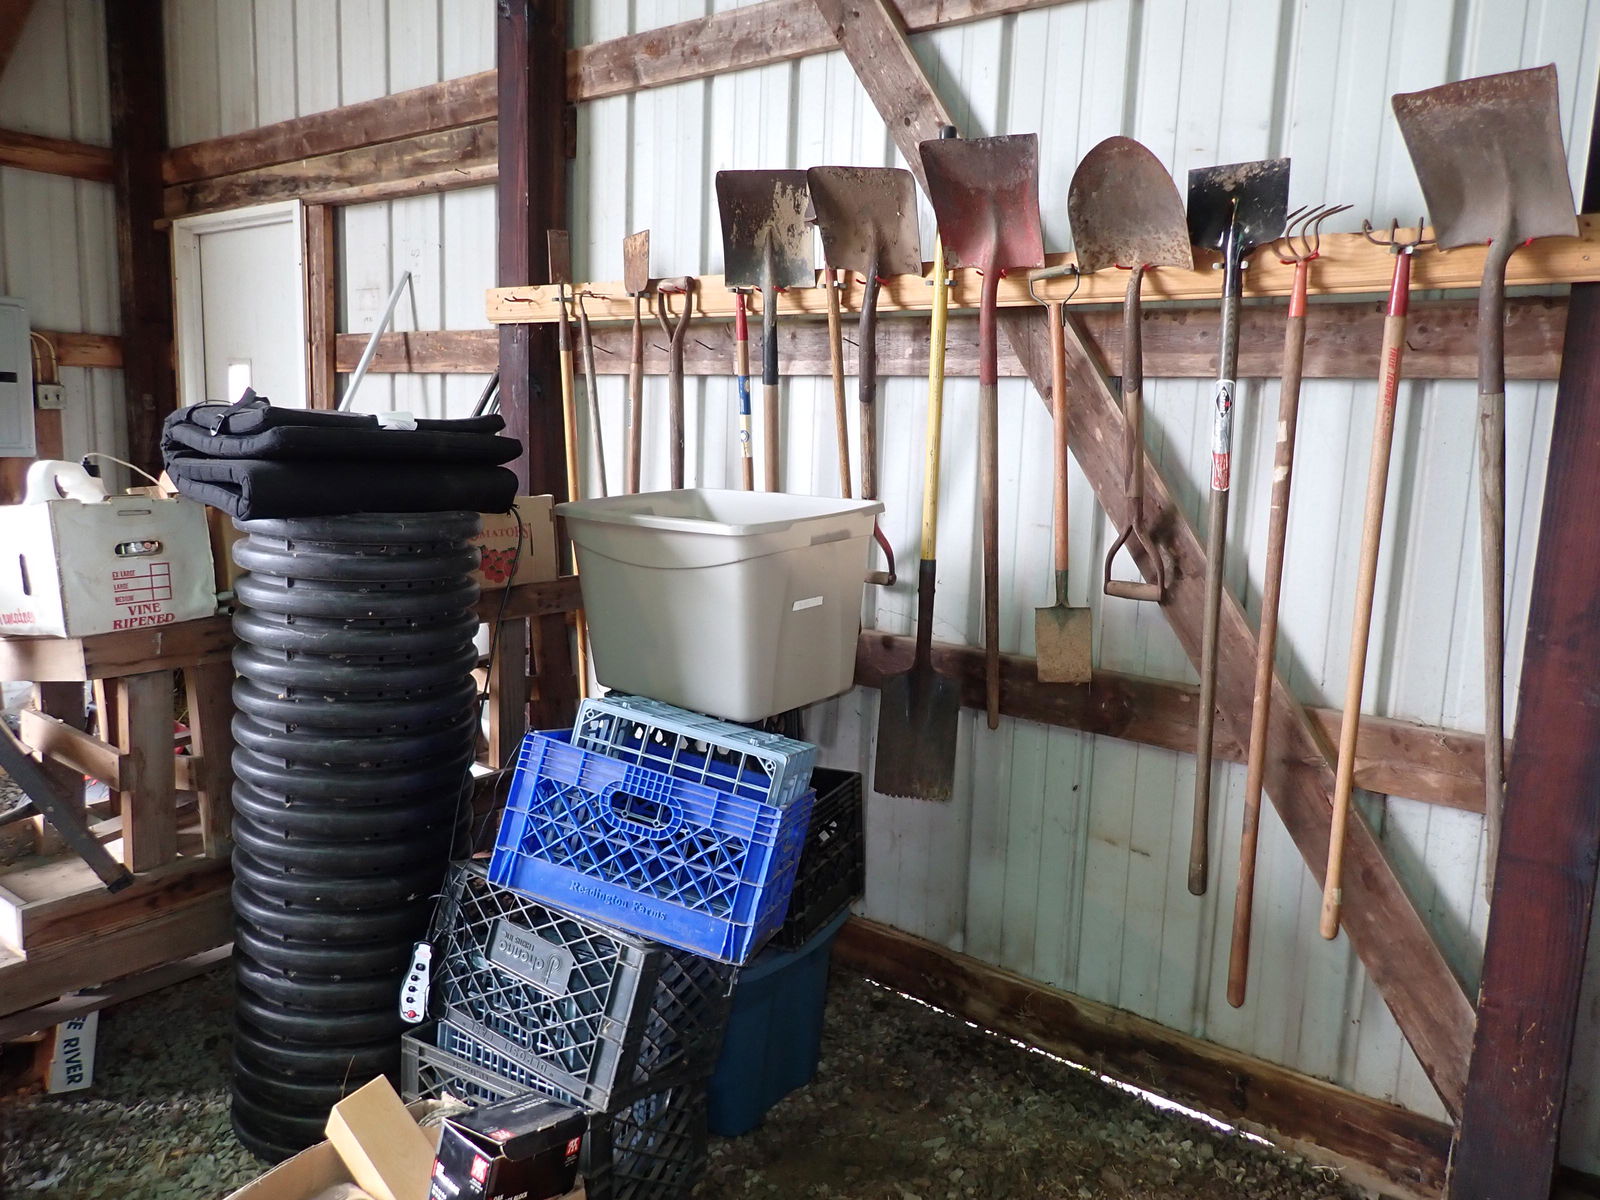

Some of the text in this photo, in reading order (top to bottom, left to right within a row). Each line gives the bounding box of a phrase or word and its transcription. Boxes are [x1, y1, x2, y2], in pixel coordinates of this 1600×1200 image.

[112, 612, 176, 630] RIPENED
[128, 602, 162, 616] VINE
[569, 880, 667, 921] Readington Farms
[63, 1036, 84, 1086] RIVER
